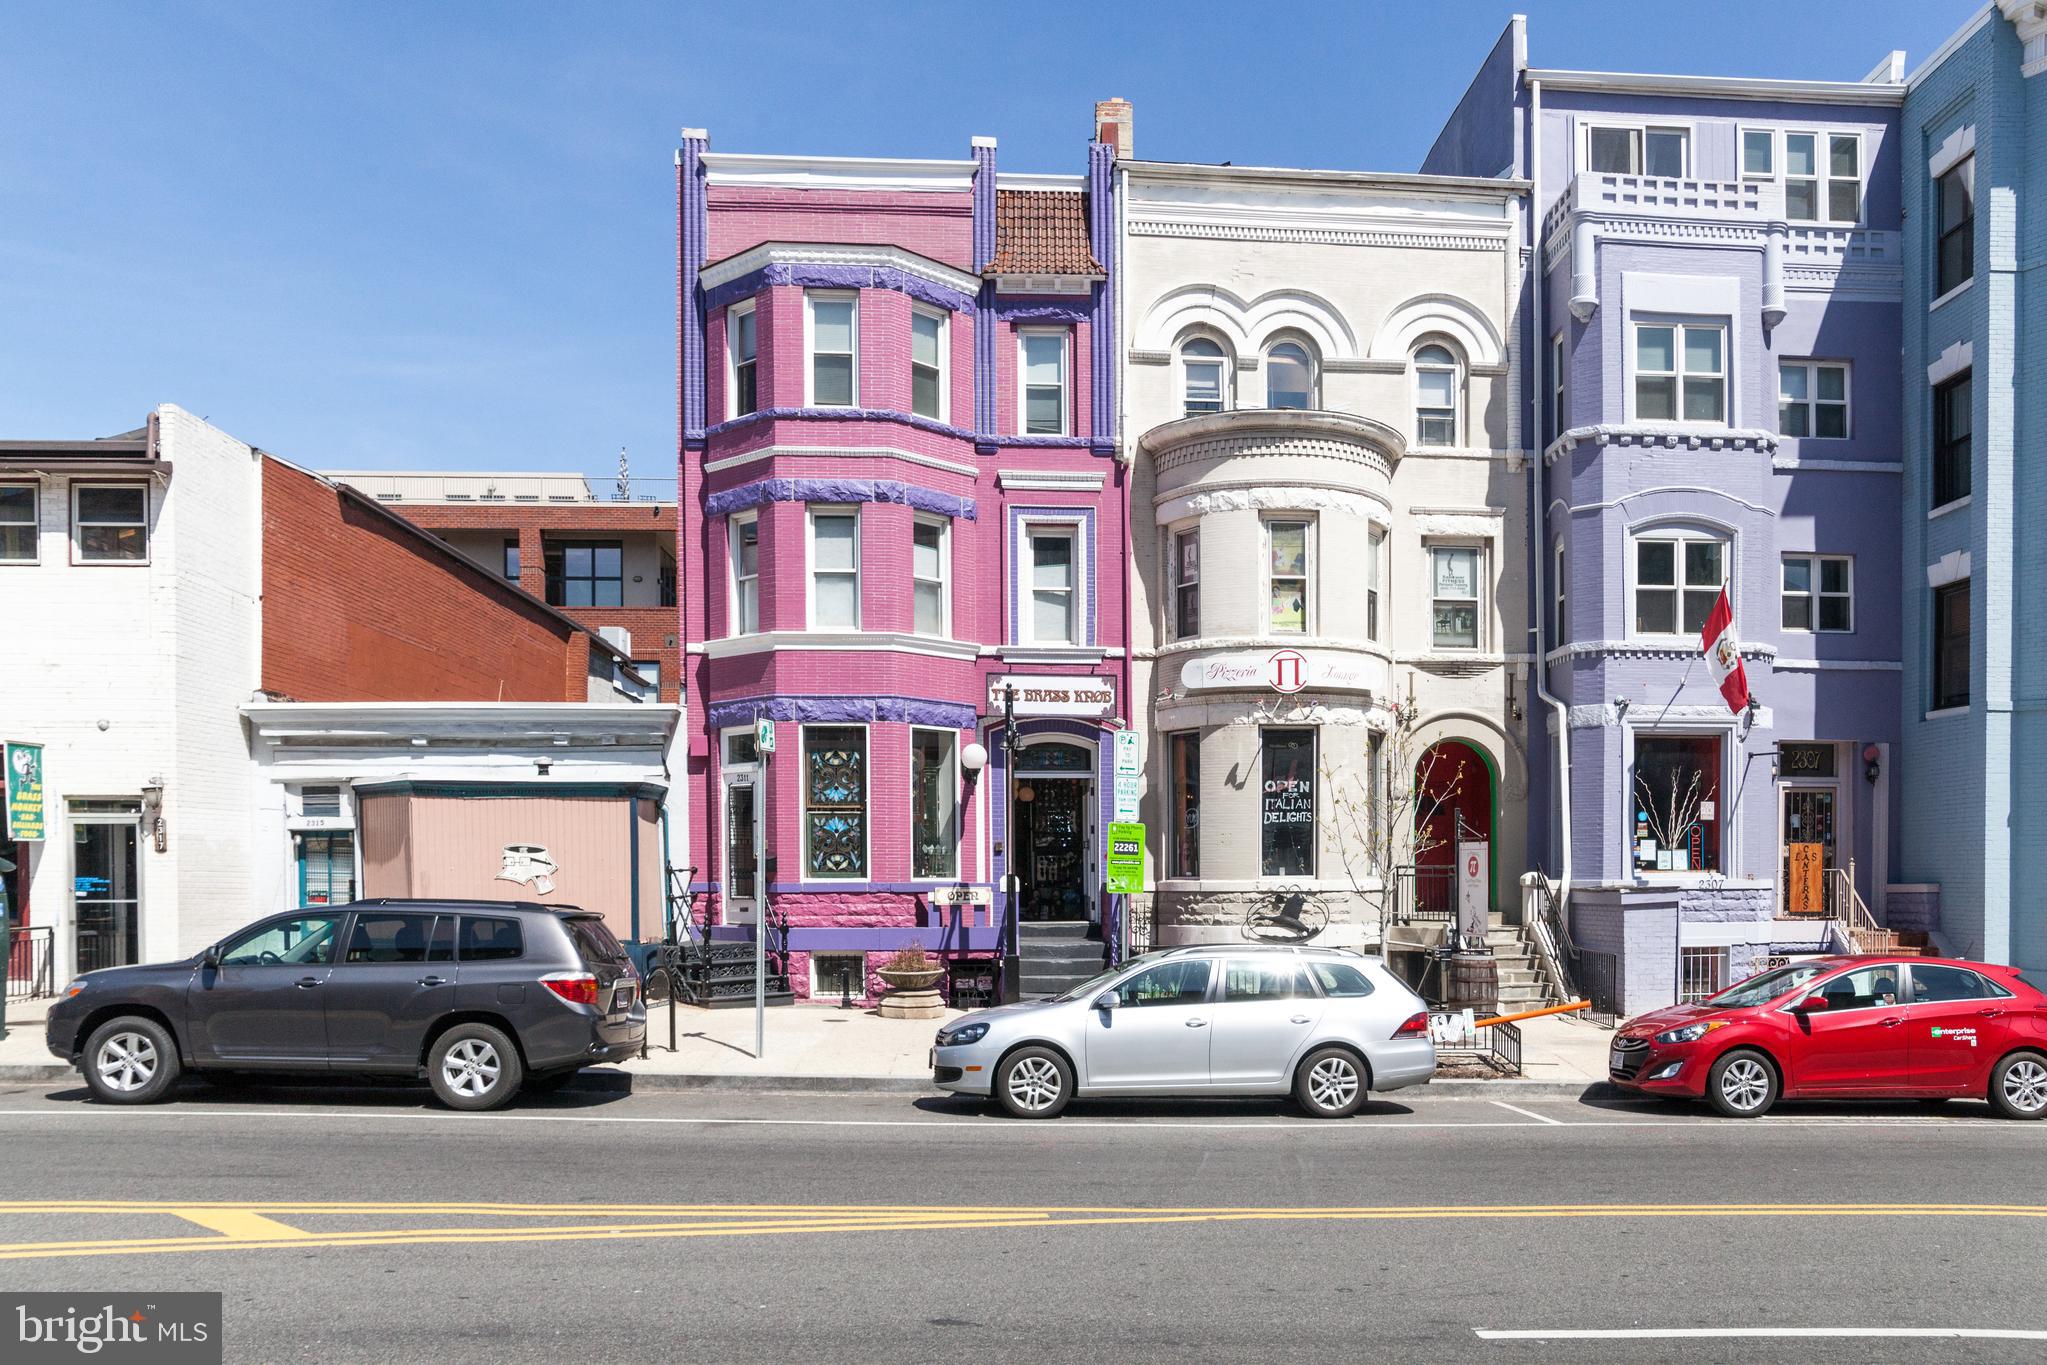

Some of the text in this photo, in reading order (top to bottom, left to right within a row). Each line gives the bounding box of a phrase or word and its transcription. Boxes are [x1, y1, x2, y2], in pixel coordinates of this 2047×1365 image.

[1207, 662, 1257, 681] Pizzeria
[991, 688, 1112, 703] TE BRASS KNOB
[1791, 751, 1822, 769] 2307
[1264, 780, 1310, 793] OPEN
[1265, 798, 1312, 810] ITALIAN
[1263, 812, 1312, 824] DELIGHTS
[1114, 843, 1139, 852] 22261
[1690, 825, 1701, 871] OPEN
[948, 891, 979, 901] OPEN
[1932, 1027, 1976, 1036] enterprise
